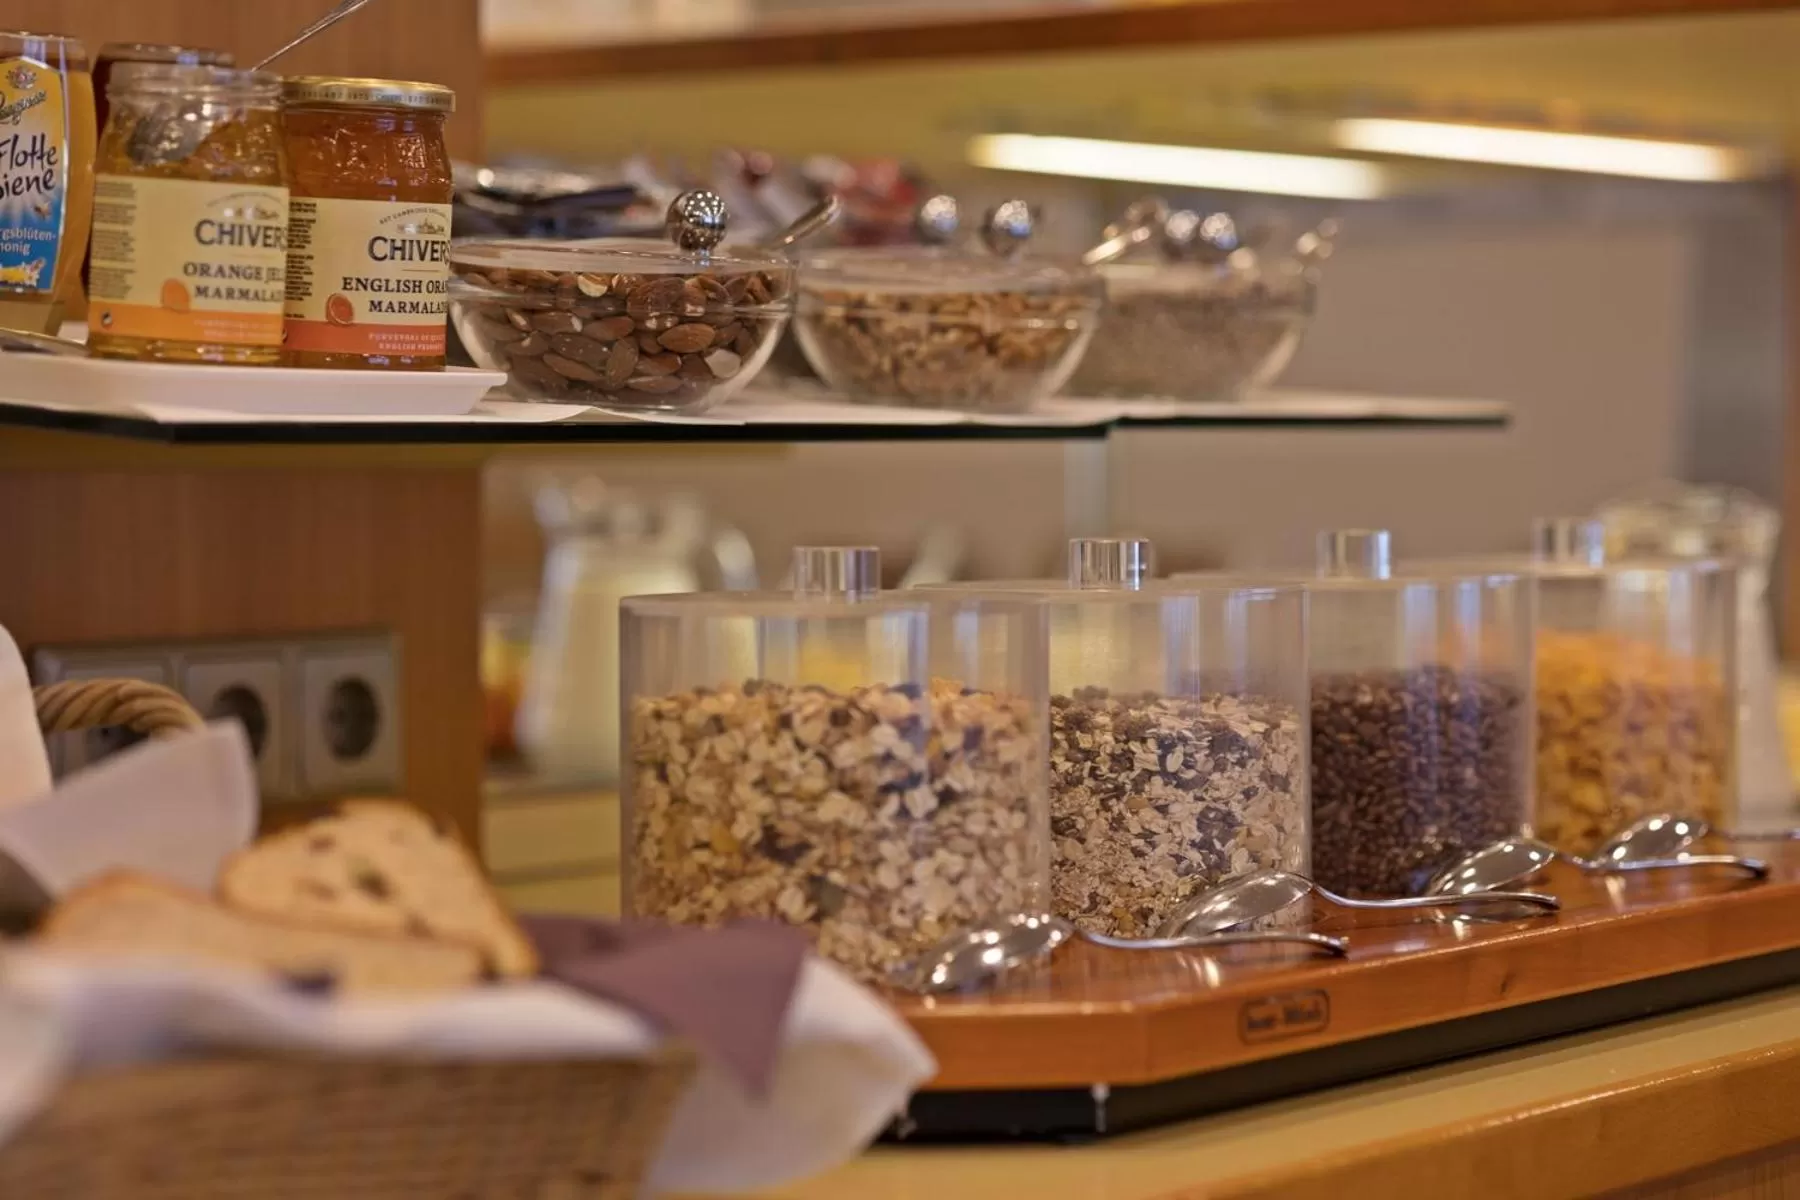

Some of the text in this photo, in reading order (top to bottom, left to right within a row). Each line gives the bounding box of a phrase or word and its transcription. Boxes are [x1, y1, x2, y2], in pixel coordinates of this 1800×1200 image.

[194, 219, 288, 251] CHIVER
[368, 236, 450, 264] CHIVER
[183, 262, 262, 281] ORANGE
[341, 276, 422, 294] ENGLISH
